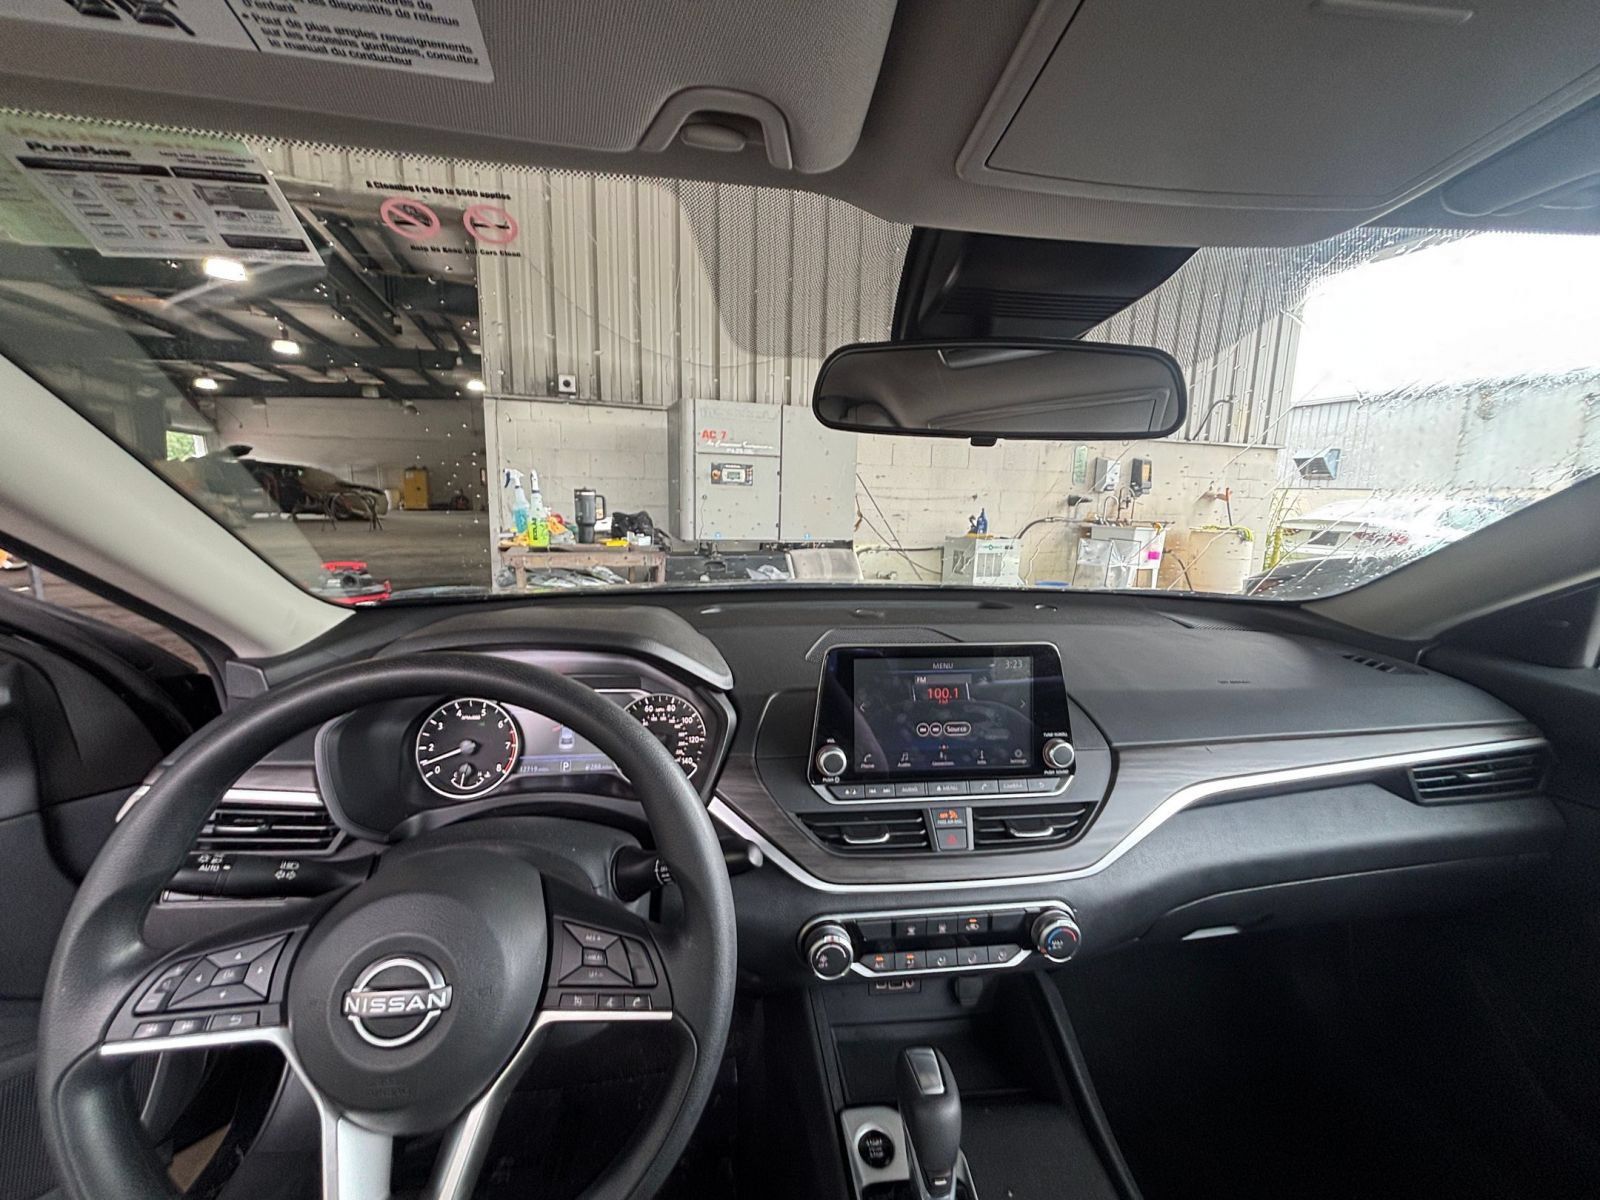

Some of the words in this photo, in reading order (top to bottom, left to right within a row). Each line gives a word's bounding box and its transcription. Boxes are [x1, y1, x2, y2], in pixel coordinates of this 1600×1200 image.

[395, 8, 411, 19] de
[413, 12, 460, 27] retenue
[285, 17, 302, 29] de
[304, 21, 332, 33] plus
[333, 26, 378, 40] amples
[380, 32, 473, 54] renseignements
[283, 40, 329, 55] manuel
[330, 48, 347, 57] du
[348, 49, 413, 66] conducteur
[305, 33, 359, 48] coussins
[426, 50, 480, 65] consultez
[373, 181, 415, 192] Cleaning
[445, 187, 455, 195] to
[479, 191, 511, 200] applies
[702, 429, 717, 439] AC
[720, 430, 727, 439] 7
[1005, 659, 1023, 669] 3:23
[916, 676, 927, 684] FM
[927, 687, 959, 699] 100.1
[666, 704, 676, 712] 80
[456, 709, 462, 717] 4
[682, 716, 693, 724] 100
[438, 722, 443, 730] 3
[498, 721, 504, 729] 6
[428, 743, 434, 752] 2
[504, 742, 511, 750] 7
[681, 757, 693, 765] 140
[434, 766, 441, 774] 0
[496, 763, 502, 772] 8
[563, 762, 569, 771] P
[198, 864, 220, 872] AUTO
[344, 991, 447, 1013] NISSAN
